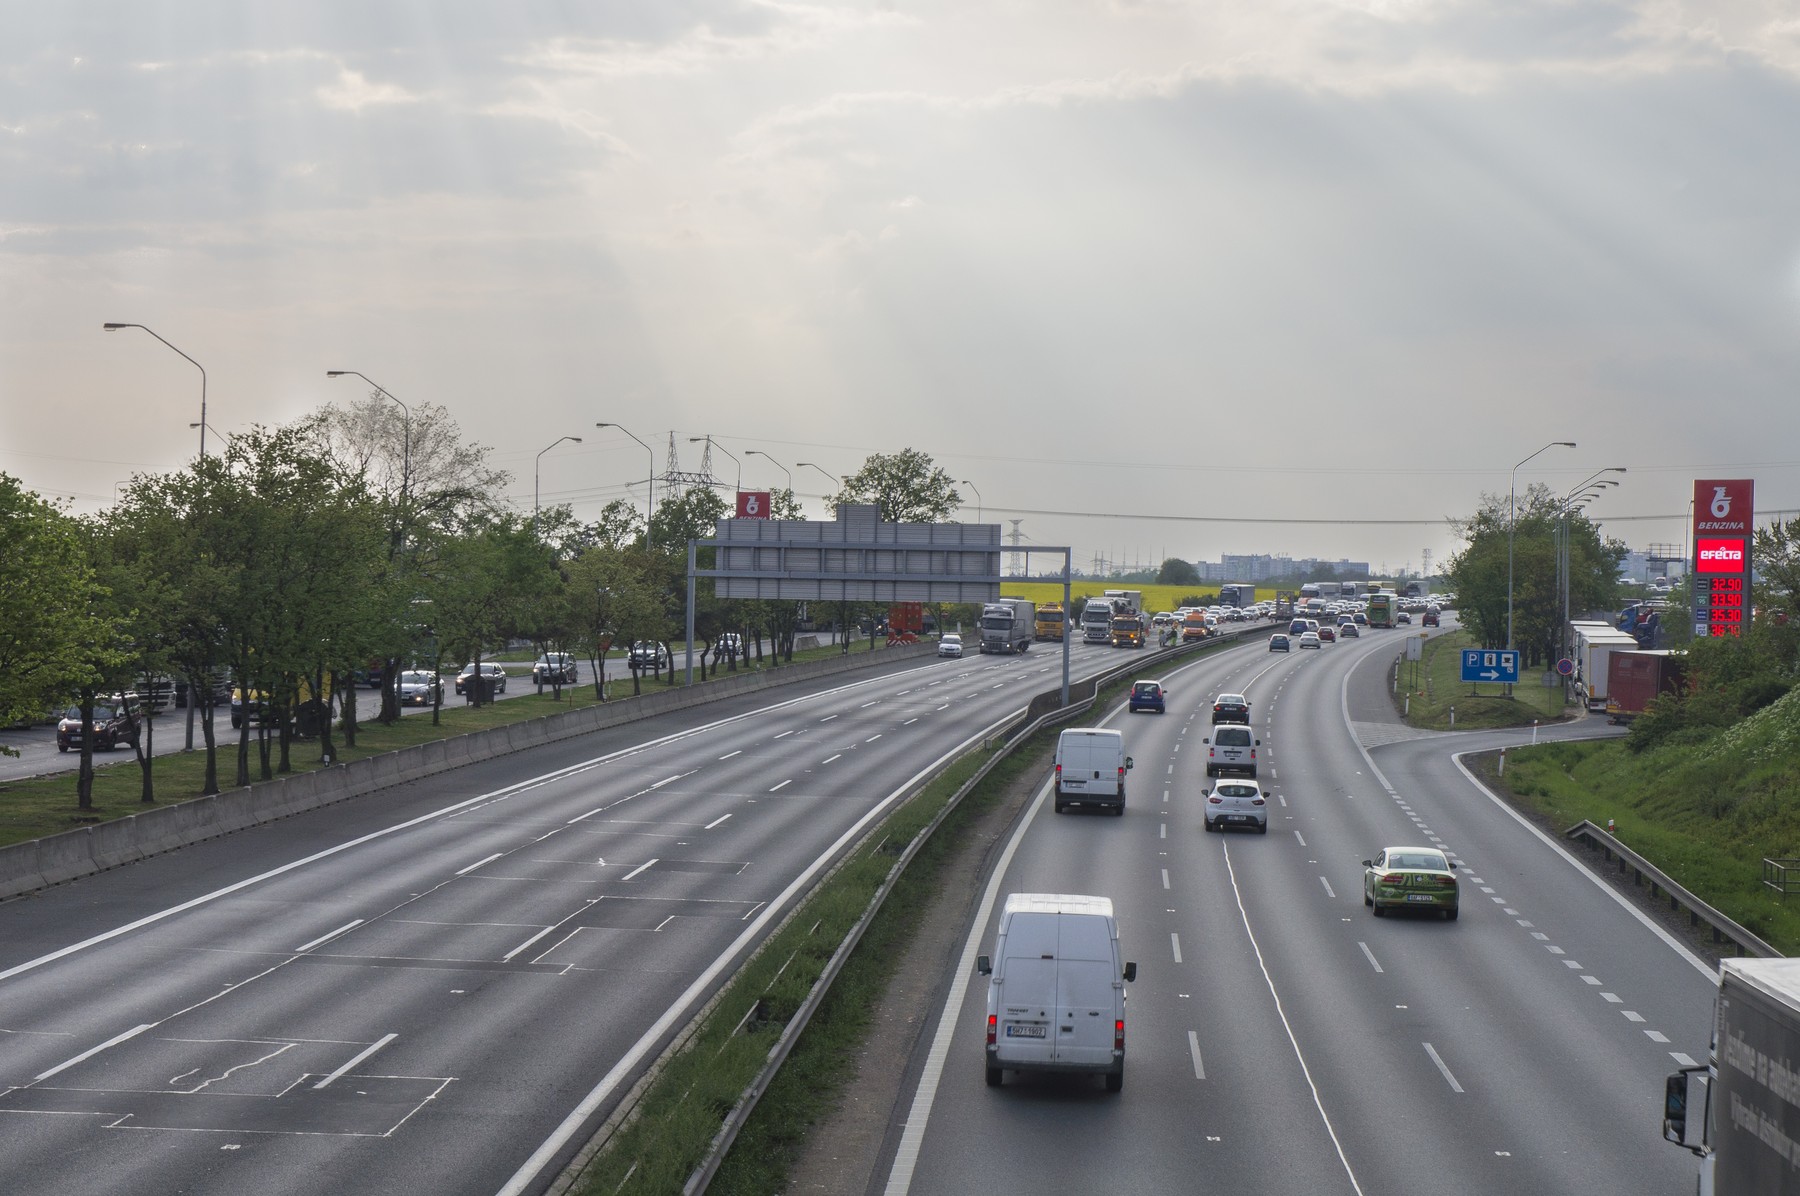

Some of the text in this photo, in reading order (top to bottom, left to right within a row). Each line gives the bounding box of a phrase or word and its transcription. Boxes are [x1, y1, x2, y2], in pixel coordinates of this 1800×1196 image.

[1698, 521, 1745, 530] BENZINA
[1711, 578, 1742, 591] 32.90
[1711, 593, 1742, 606] 33.90
[1711, 609, 1741, 622] 35.30
[1469, 653, 1477, 665] P
